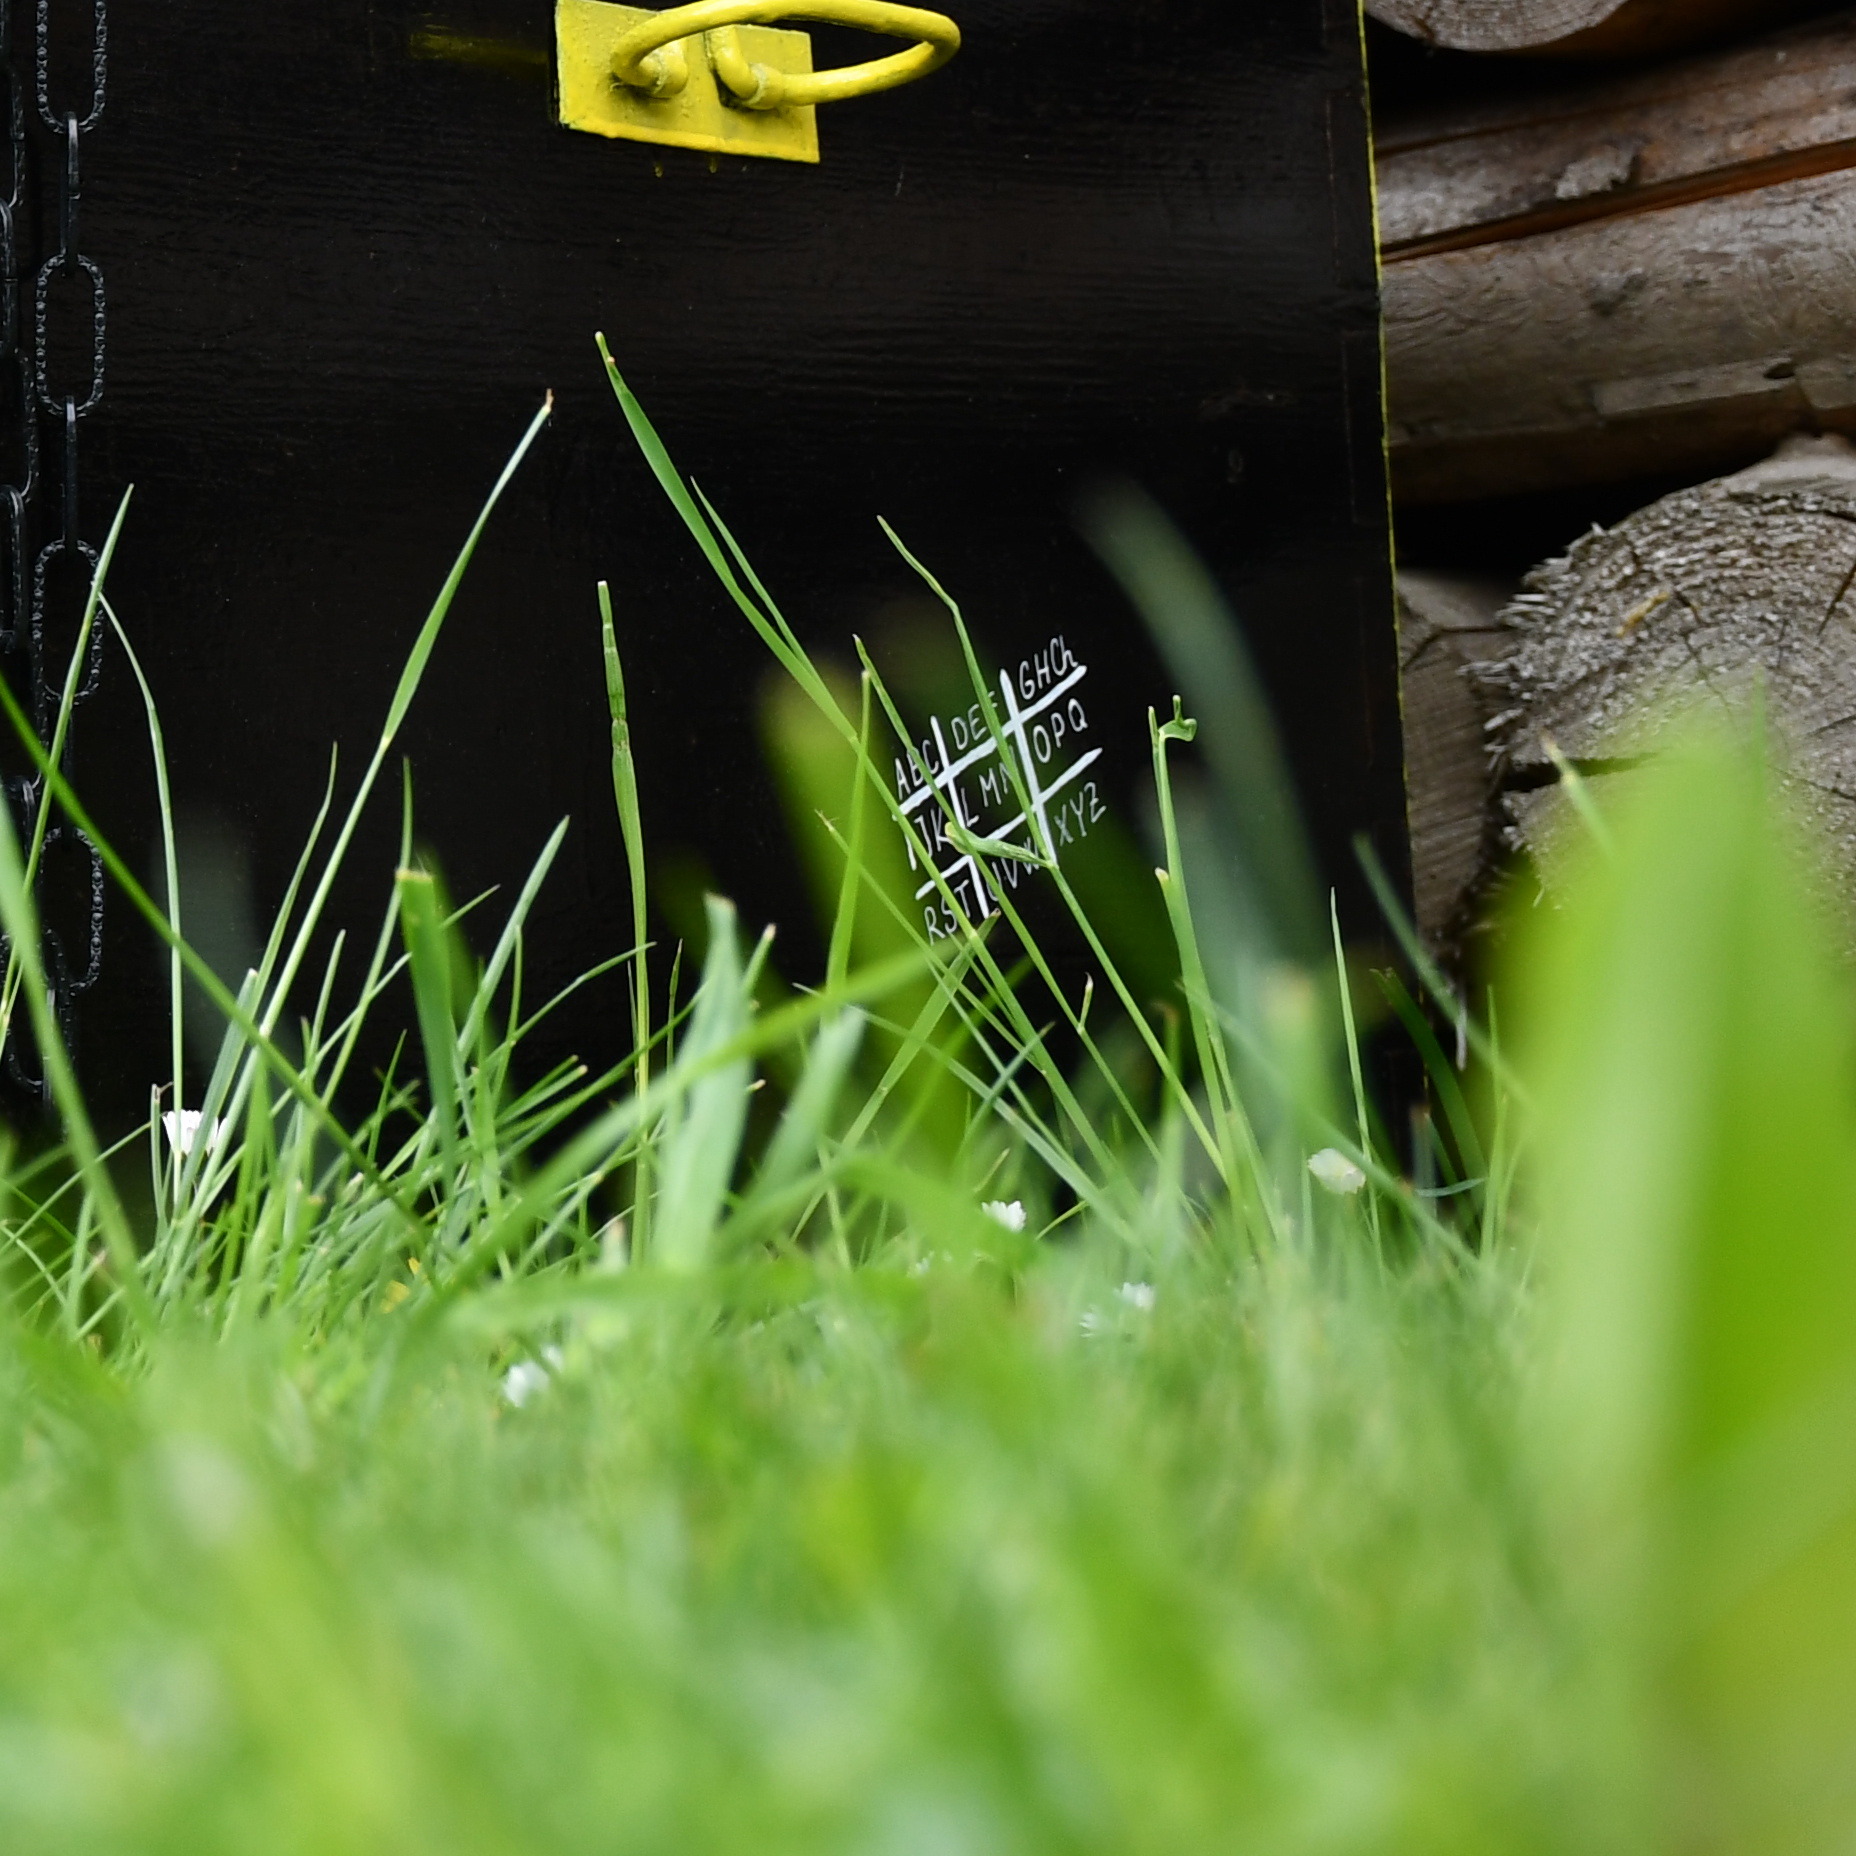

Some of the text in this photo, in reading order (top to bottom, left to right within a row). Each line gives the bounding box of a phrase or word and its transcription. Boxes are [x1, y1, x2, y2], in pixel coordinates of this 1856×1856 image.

[1019, 635, 1078, 700] GHCh
[1033, 698, 1088, 763] OPQ
[1054, 782, 1107, 846] XYZ
